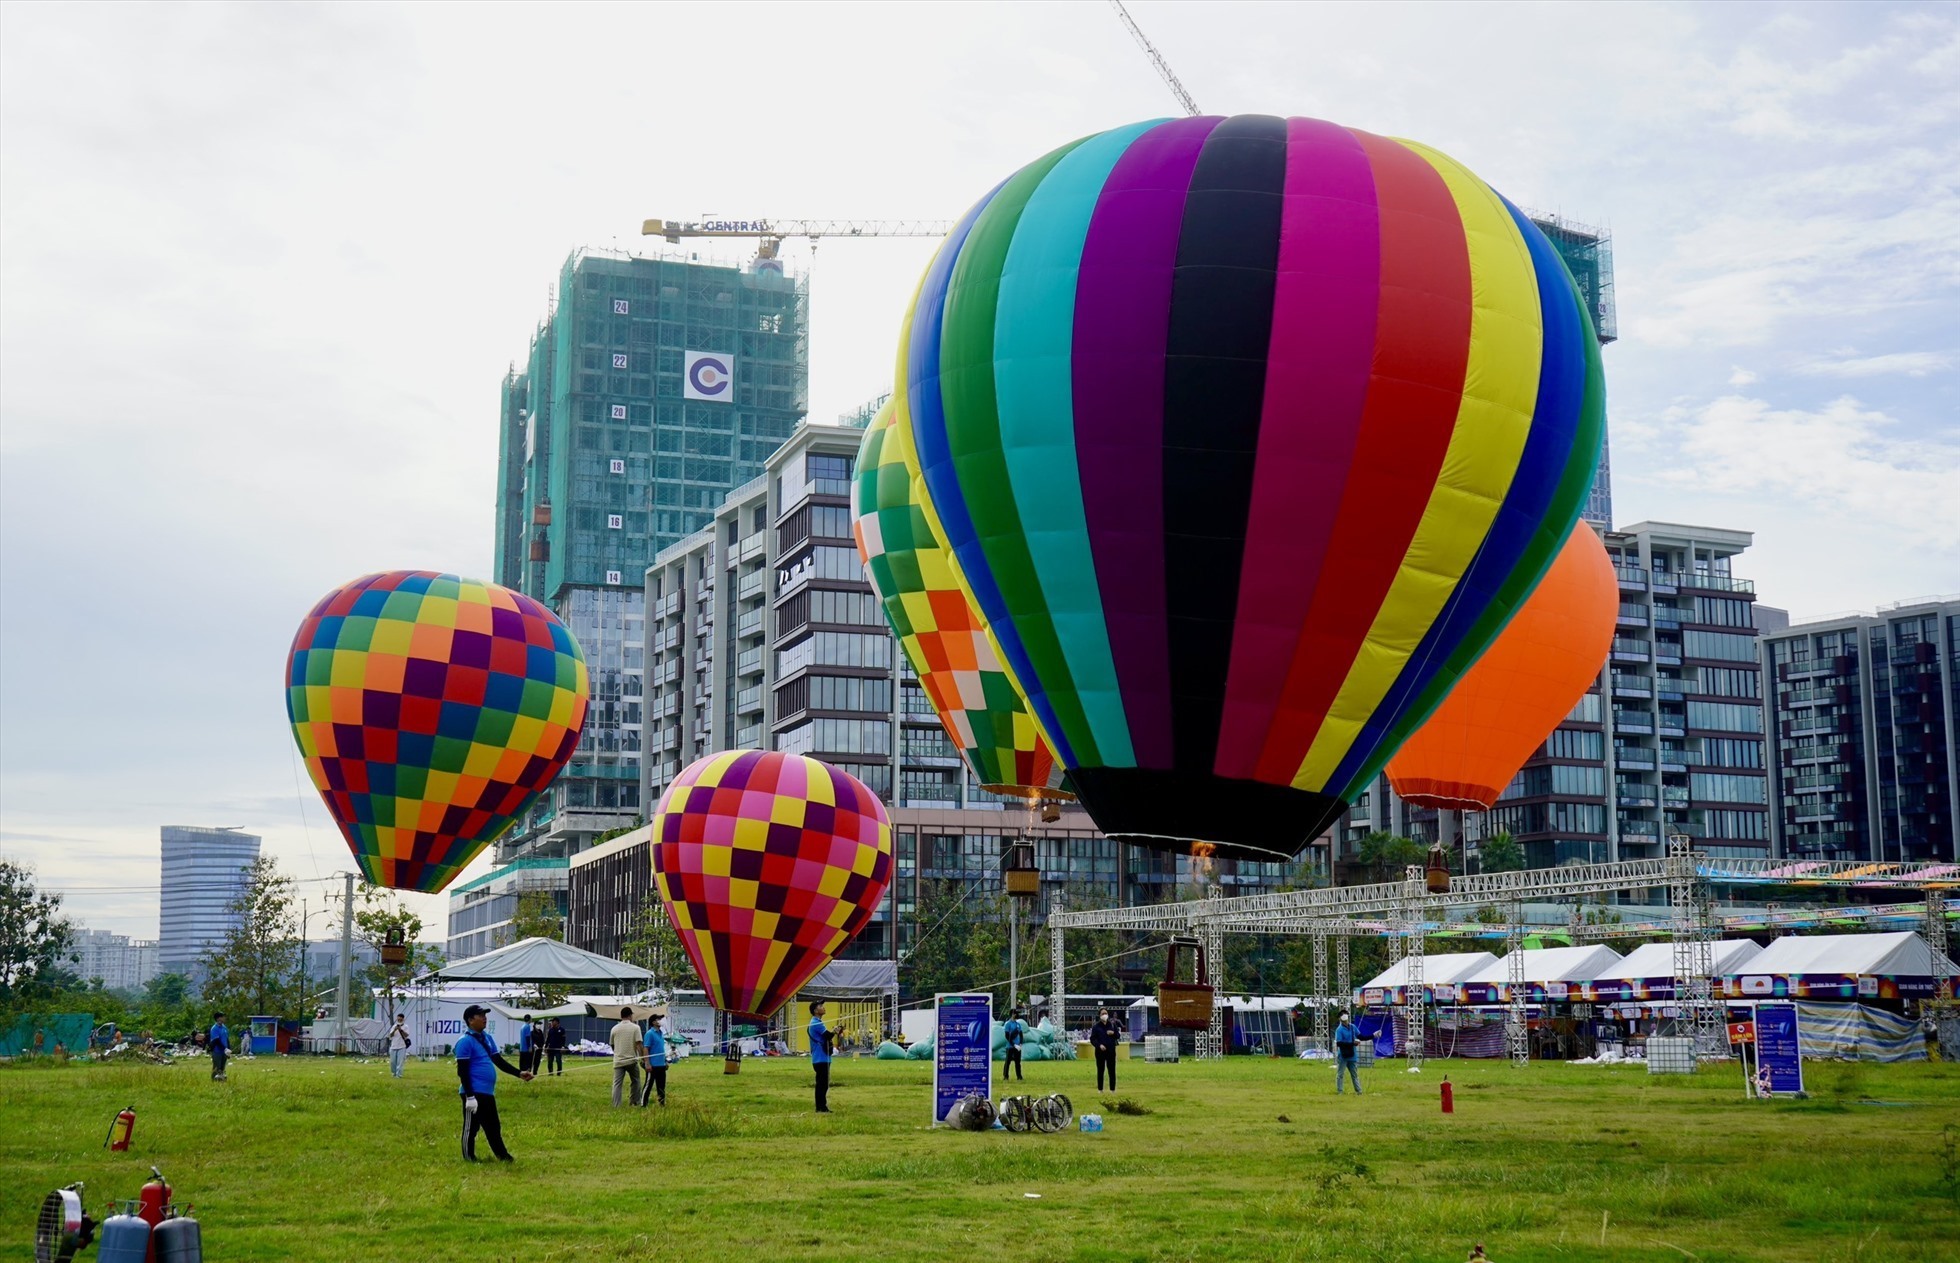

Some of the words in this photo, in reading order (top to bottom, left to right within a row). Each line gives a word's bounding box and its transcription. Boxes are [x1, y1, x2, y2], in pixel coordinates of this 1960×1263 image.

[705, 220, 768, 232] CENTRAL
[615, 301, 627, 313] 24
[613, 356, 626, 367] 22
[613, 407, 624, 417] 20
[612, 462, 622, 471] 18
[610, 516, 620, 526] 16
[609, 573, 619, 582] 14
